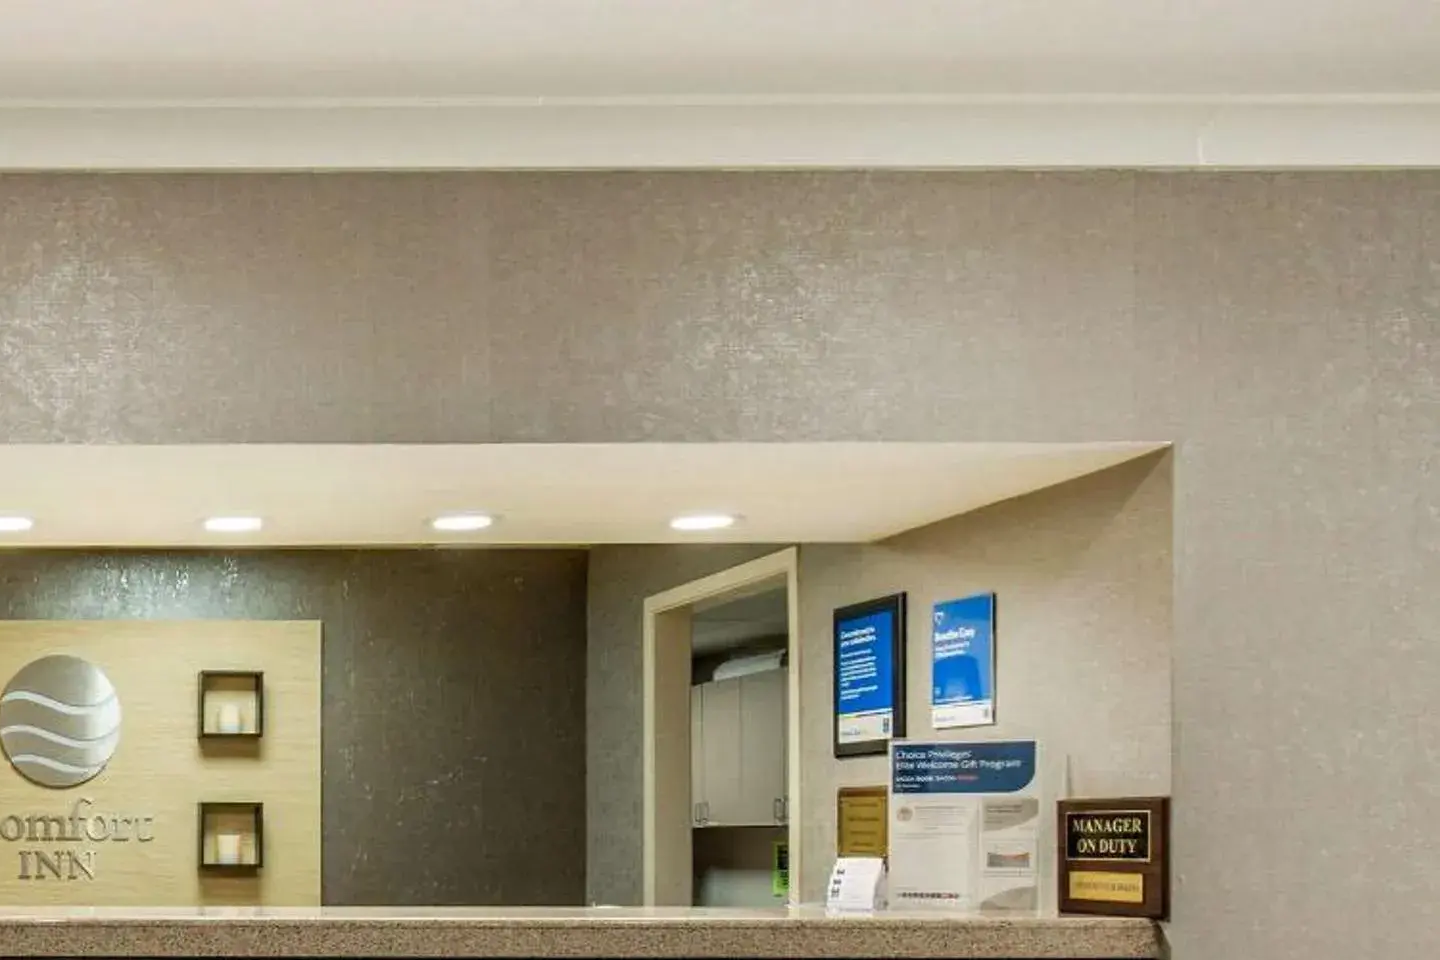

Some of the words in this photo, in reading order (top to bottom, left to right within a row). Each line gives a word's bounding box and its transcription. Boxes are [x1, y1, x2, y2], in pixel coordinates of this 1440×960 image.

[896, 750, 926, 759] Choice
[980, 759, 1021, 770] Program
[1073, 817, 1142, 833] MANAGER
[1077, 838, 1097, 854] ON
[1099, 838, 1137, 854] DUTY
[18, 850, 96, 880] INN
